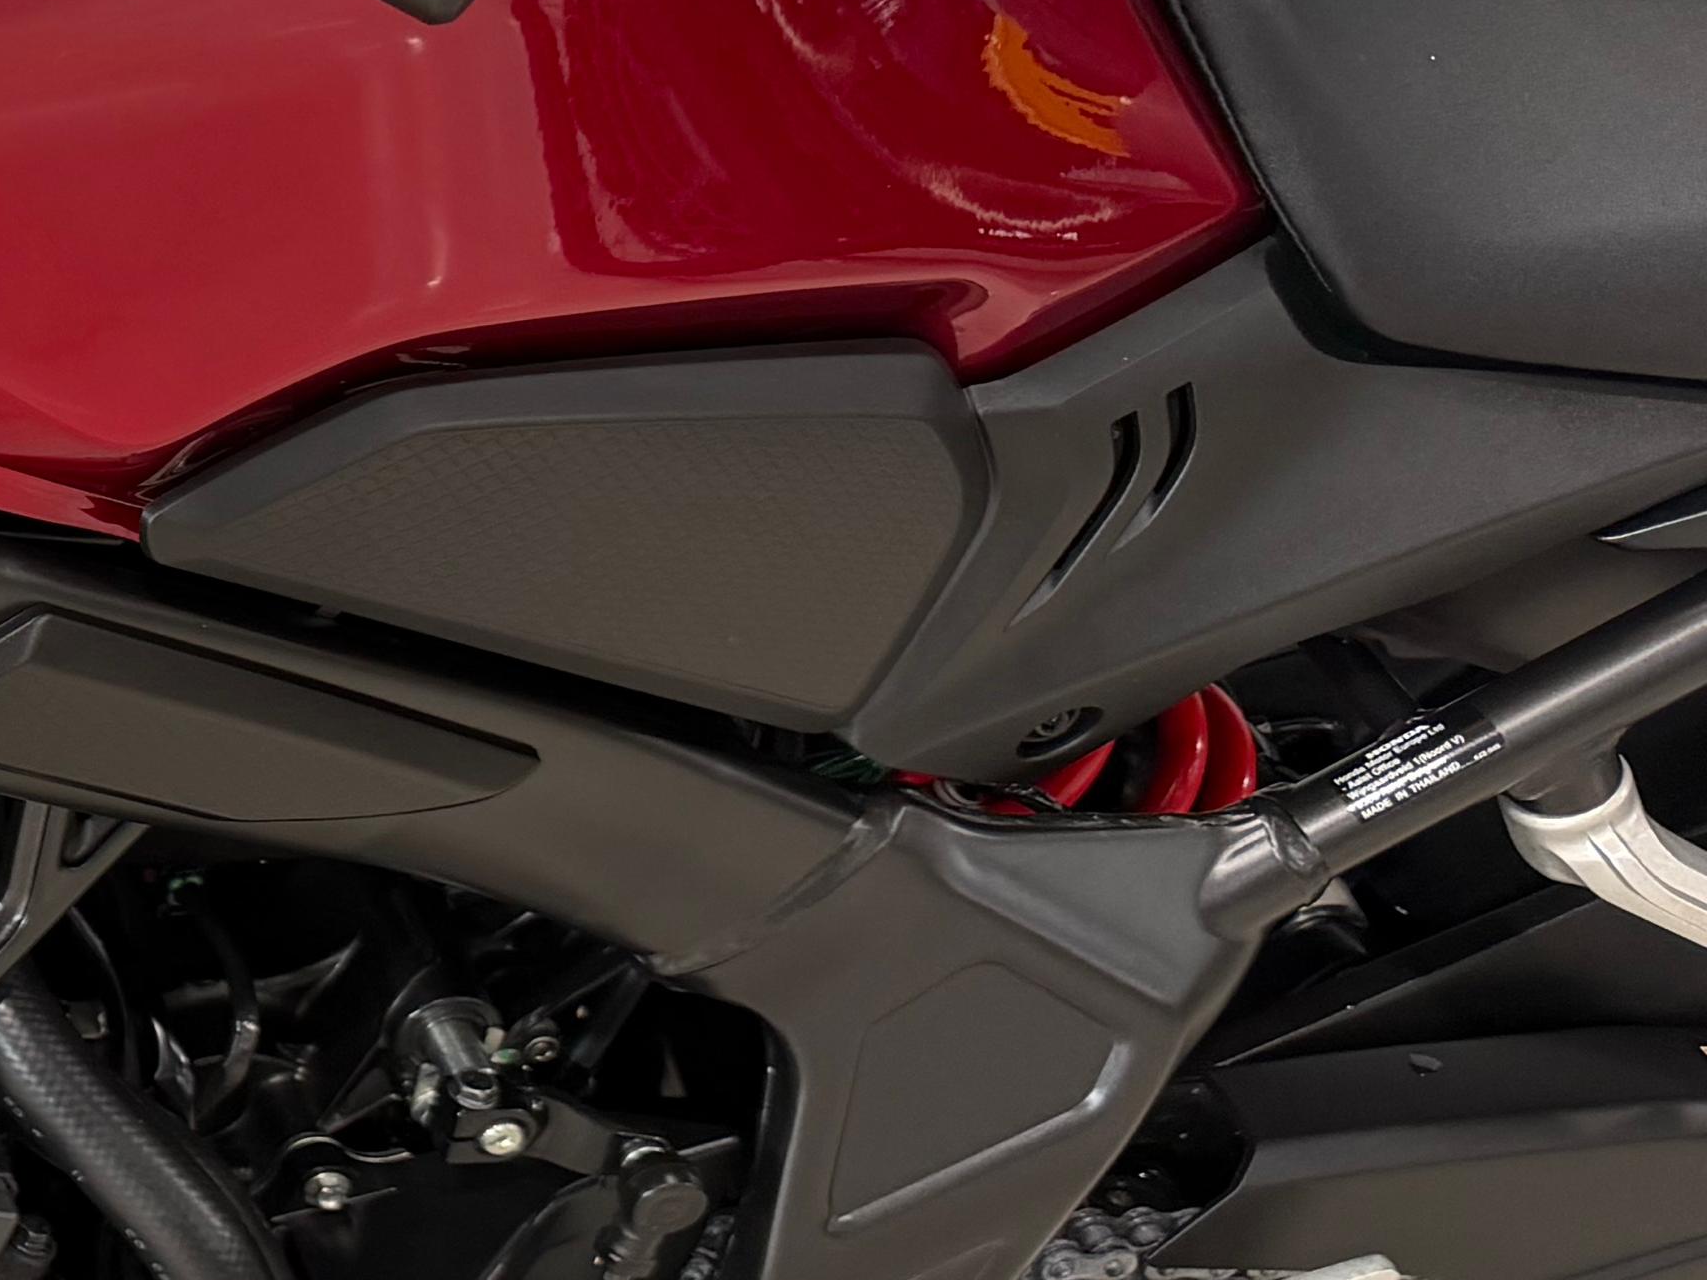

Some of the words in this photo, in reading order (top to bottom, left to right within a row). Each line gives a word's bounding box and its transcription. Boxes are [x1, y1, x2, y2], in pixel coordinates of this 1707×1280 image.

[1333, 766, 1366, 786] Honda
[1392, 733, 1429, 755] Europe
[1365, 724, 1431, 760] HONDA
[1361, 800, 1394, 820] MADE
[1394, 788, 1410, 802] IN
[1407, 761, 1461, 794] THAILAND
